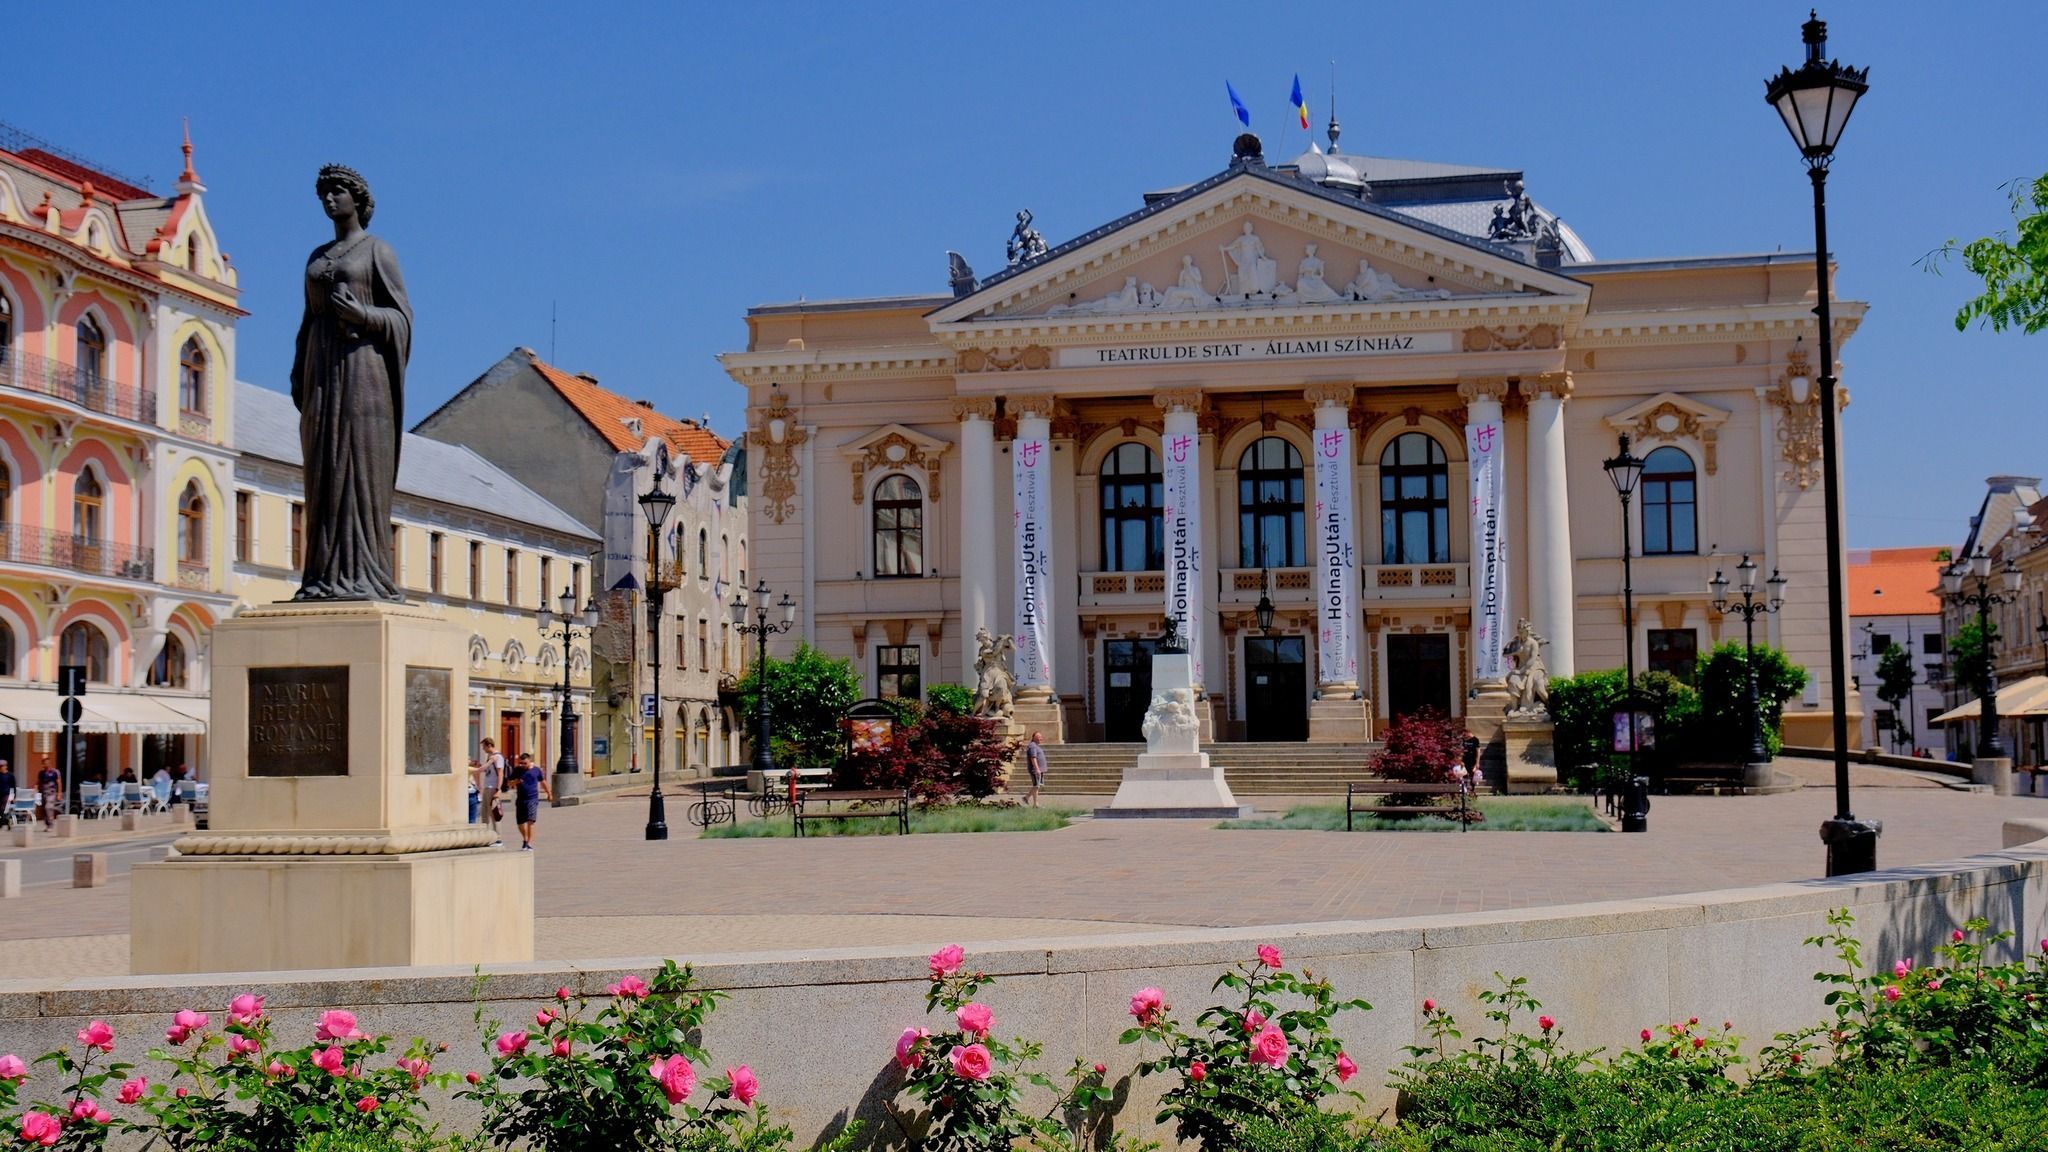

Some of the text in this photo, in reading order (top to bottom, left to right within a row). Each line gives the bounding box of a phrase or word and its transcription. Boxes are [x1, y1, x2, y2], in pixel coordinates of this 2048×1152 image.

[1097, 343, 1242, 361] TEATRUL DE STAT
[1265, 334, 1414, 355] ÁLLAMI SZÍNHÁZ
[1177, 465, 1186, 515] Fesztivál
[1022, 470, 1037, 680] Festivalul HolnapUtán Fesztivál
[1173, 517, 1188, 622] HolnapUtán
[1326, 461, 1343, 676] Festivalul HolnapUtán Fesztivál
[263, 683, 330, 701] MARIA
[260, 703, 336, 721] REGINA
